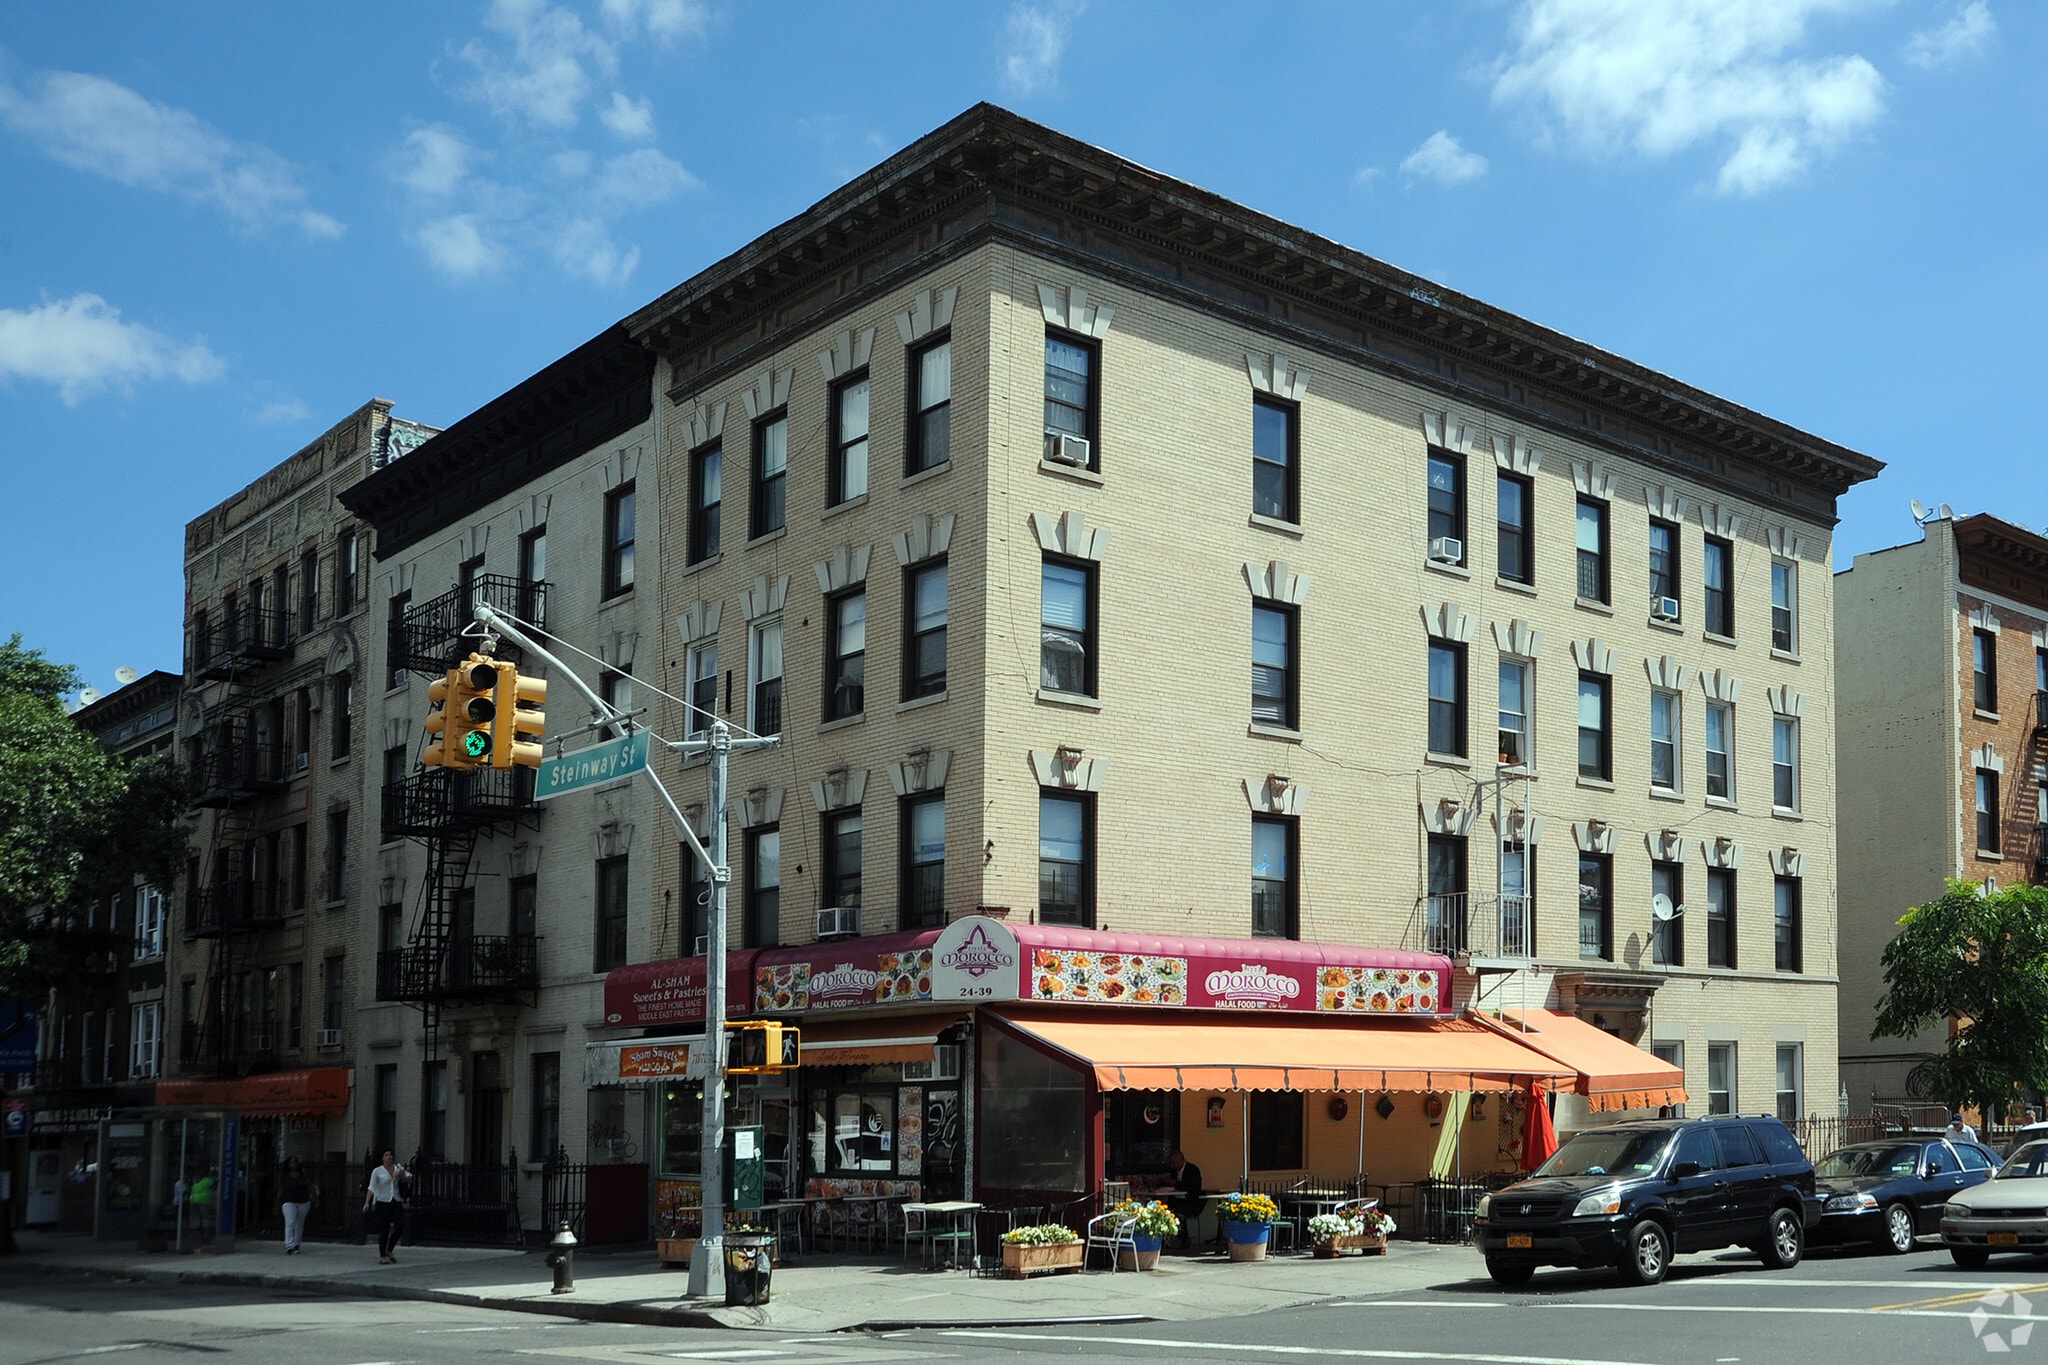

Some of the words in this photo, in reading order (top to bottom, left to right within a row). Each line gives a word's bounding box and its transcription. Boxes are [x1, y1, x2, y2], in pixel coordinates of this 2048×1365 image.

[551, 753, 618, 786] Steinway
[620, 744, 636, 768] St
[941, 953, 1013, 966] MOROCCO
[650, 975, 692, 990] AL-SHAM
[810, 970, 876, 993] MOROCCO
[1207, 972, 1298, 996] MOROCCO
[663, 990, 672, 1000] &
[673, 986, 707, 999] Pastries
[960, 987, 992, 997] 24-39
[637, 1004, 648, 1012] THE
[648, 1002, 667, 1011] FINEST
[668, 1000, 684, 1010] HOME
[685, 998, 702, 1008] MADE
[811, 1001, 830, 1009] HALAL
[830, 999, 847, 1008] FOOD
[1215, 1000, 1236, 1009] HALAL
[1237, 1000, 1256, 1009] FOOD
[638, 1011, 658, 1021] MIDDLE
[659, 1009, 673, 1019] EAST
[674, 1007, 701, 1018] PASTRIES
[631, 1051, 651, 1064] Sham
[652, 1047, 678, 1062] Sweets
